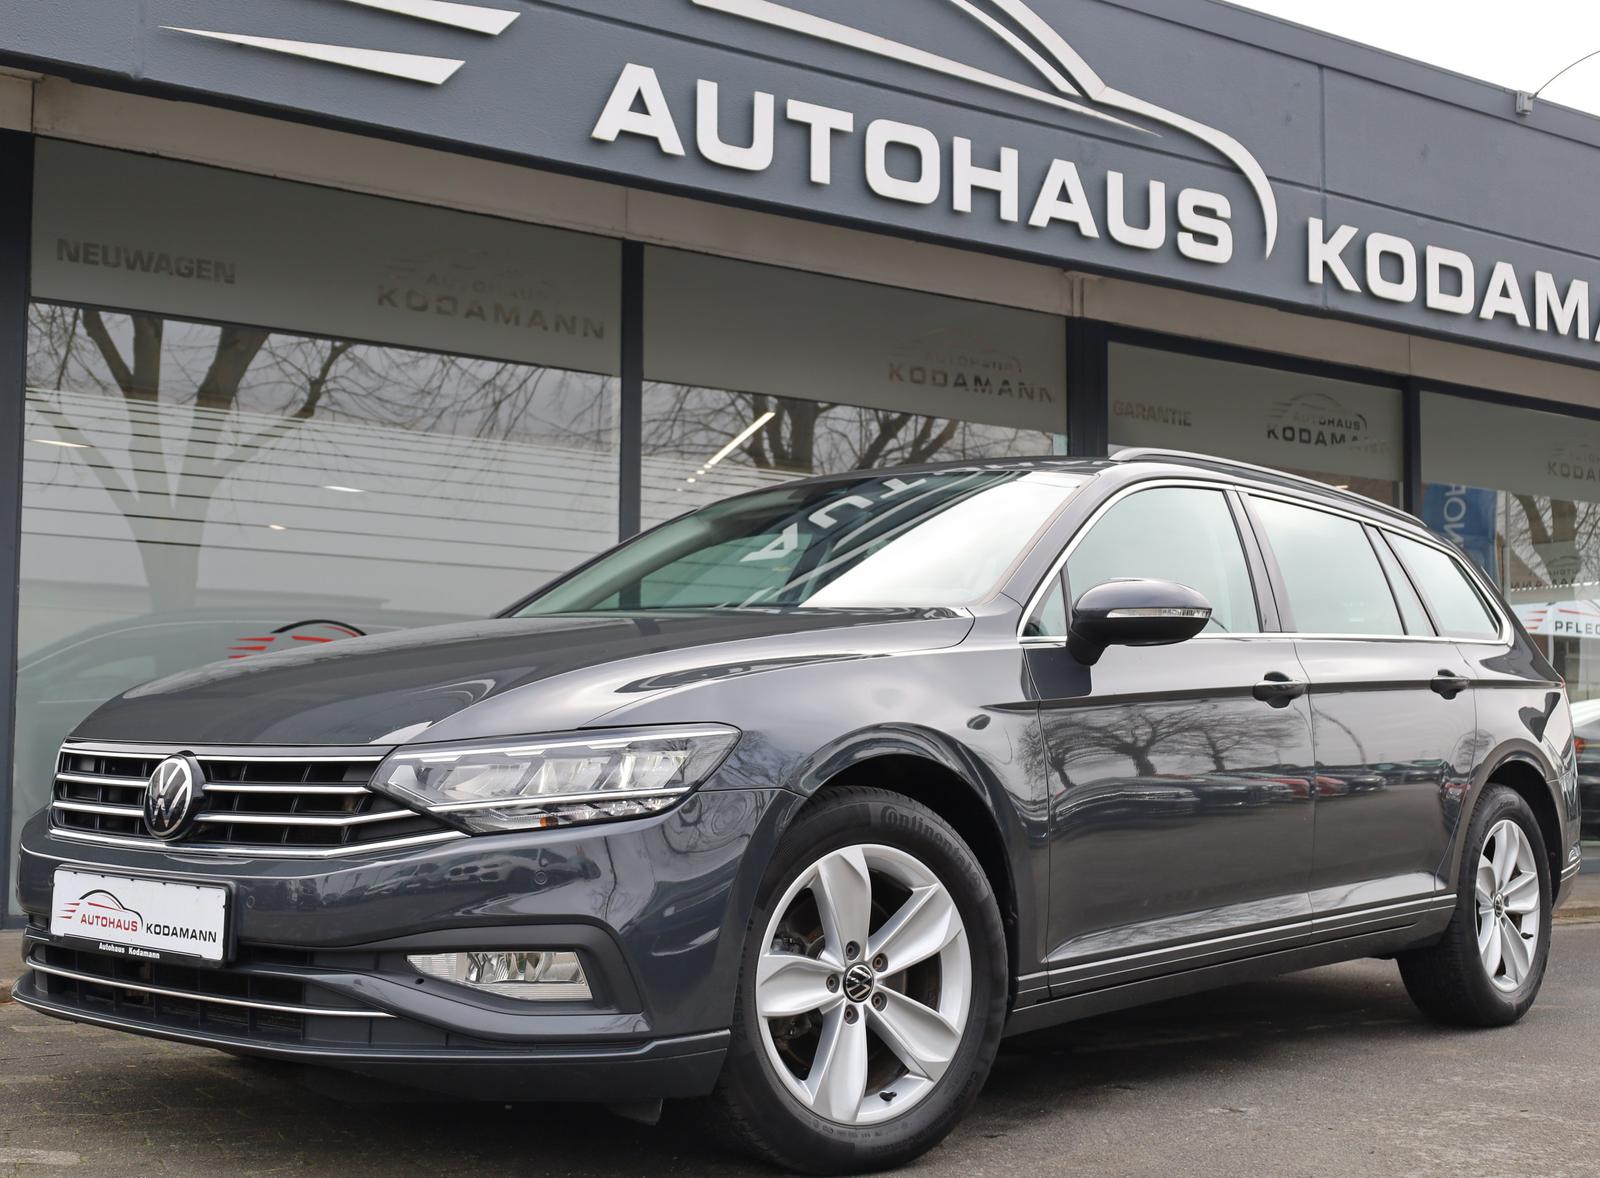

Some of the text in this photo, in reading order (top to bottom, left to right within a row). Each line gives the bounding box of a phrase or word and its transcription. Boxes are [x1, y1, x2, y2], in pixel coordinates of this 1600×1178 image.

[591, 62, 1233, 264] AUTOHAUS
[57, 238, 236, 284] NEUWAGEN
[377, 285, 605, 340] KODAMANN
[888, 363, 1056, 403] KODAMANN
[1112, 400, 1192, 428] GARANTIE
[1547, 461, 1600, 483] KODA
[80, 913, 217, 944] AUTOHAUS KODAMANN
[98, 942, 161, 960] Autohaus Kodamann
